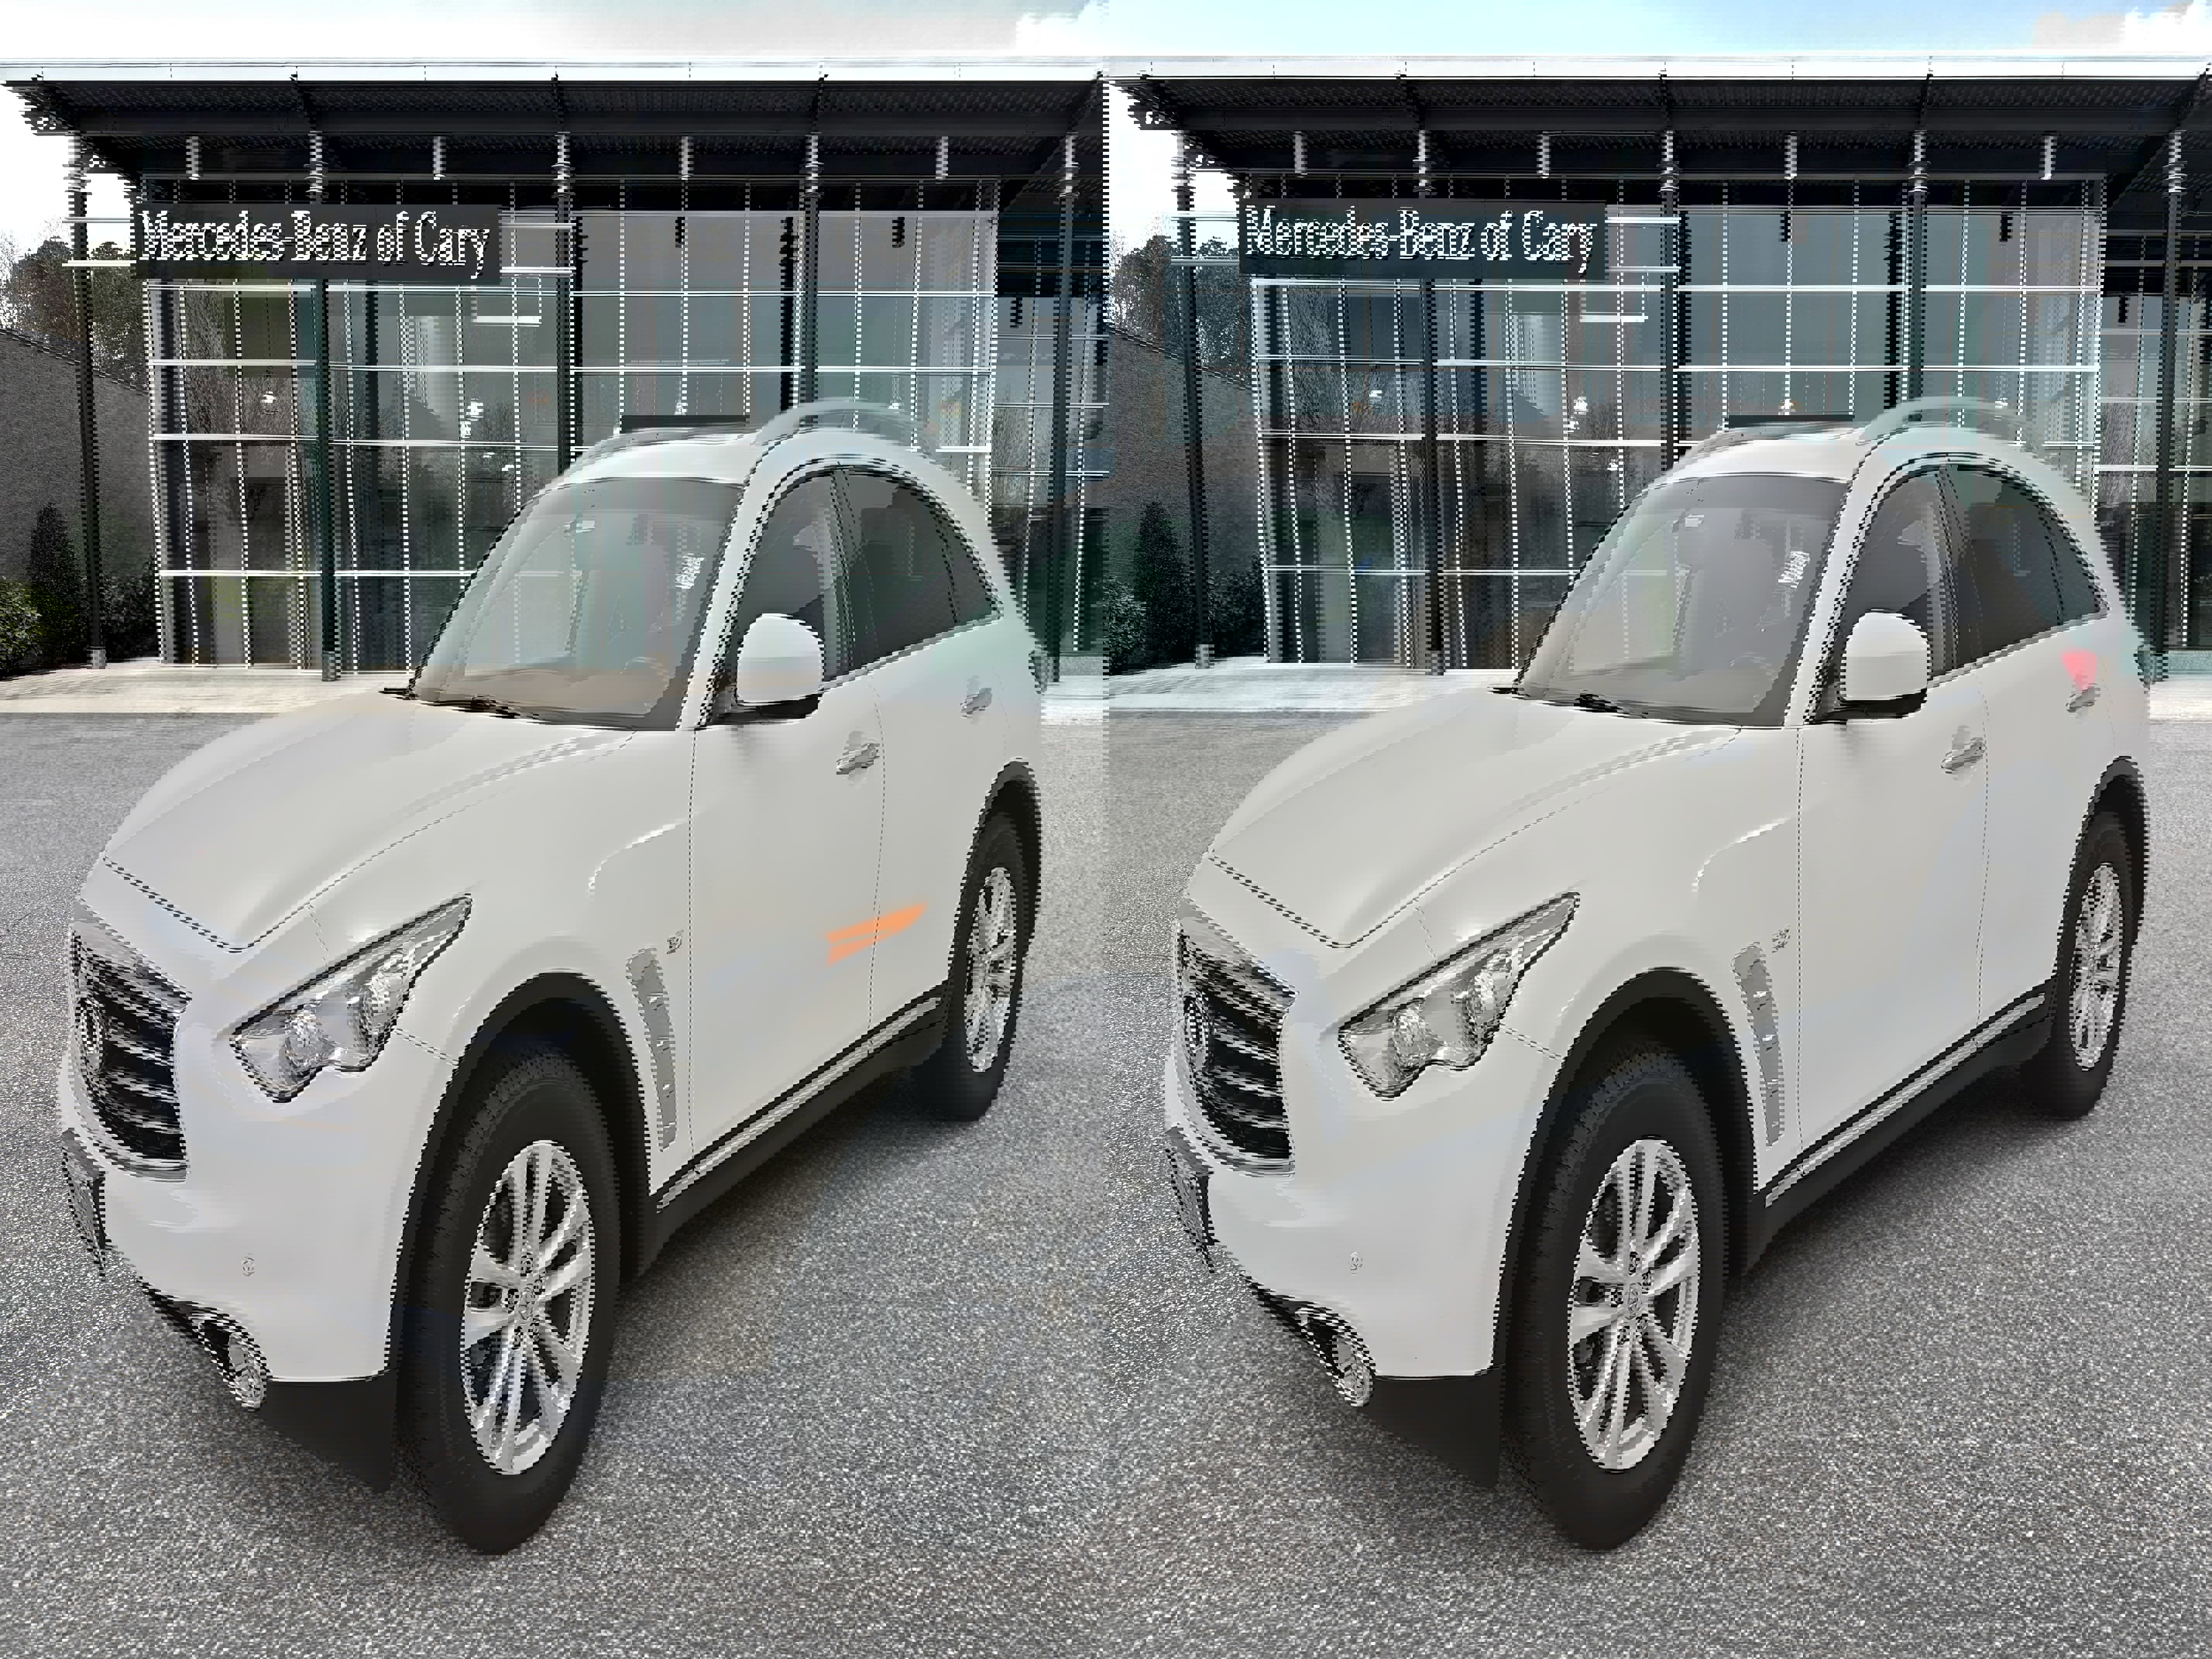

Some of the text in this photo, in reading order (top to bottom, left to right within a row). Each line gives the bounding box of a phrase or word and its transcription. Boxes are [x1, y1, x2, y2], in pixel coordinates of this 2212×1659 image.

[137, 210, 490, 279] Mercedes-Benz of Cary
[1245, 205, 1598, 273] Mercedes-Benz of Cary
